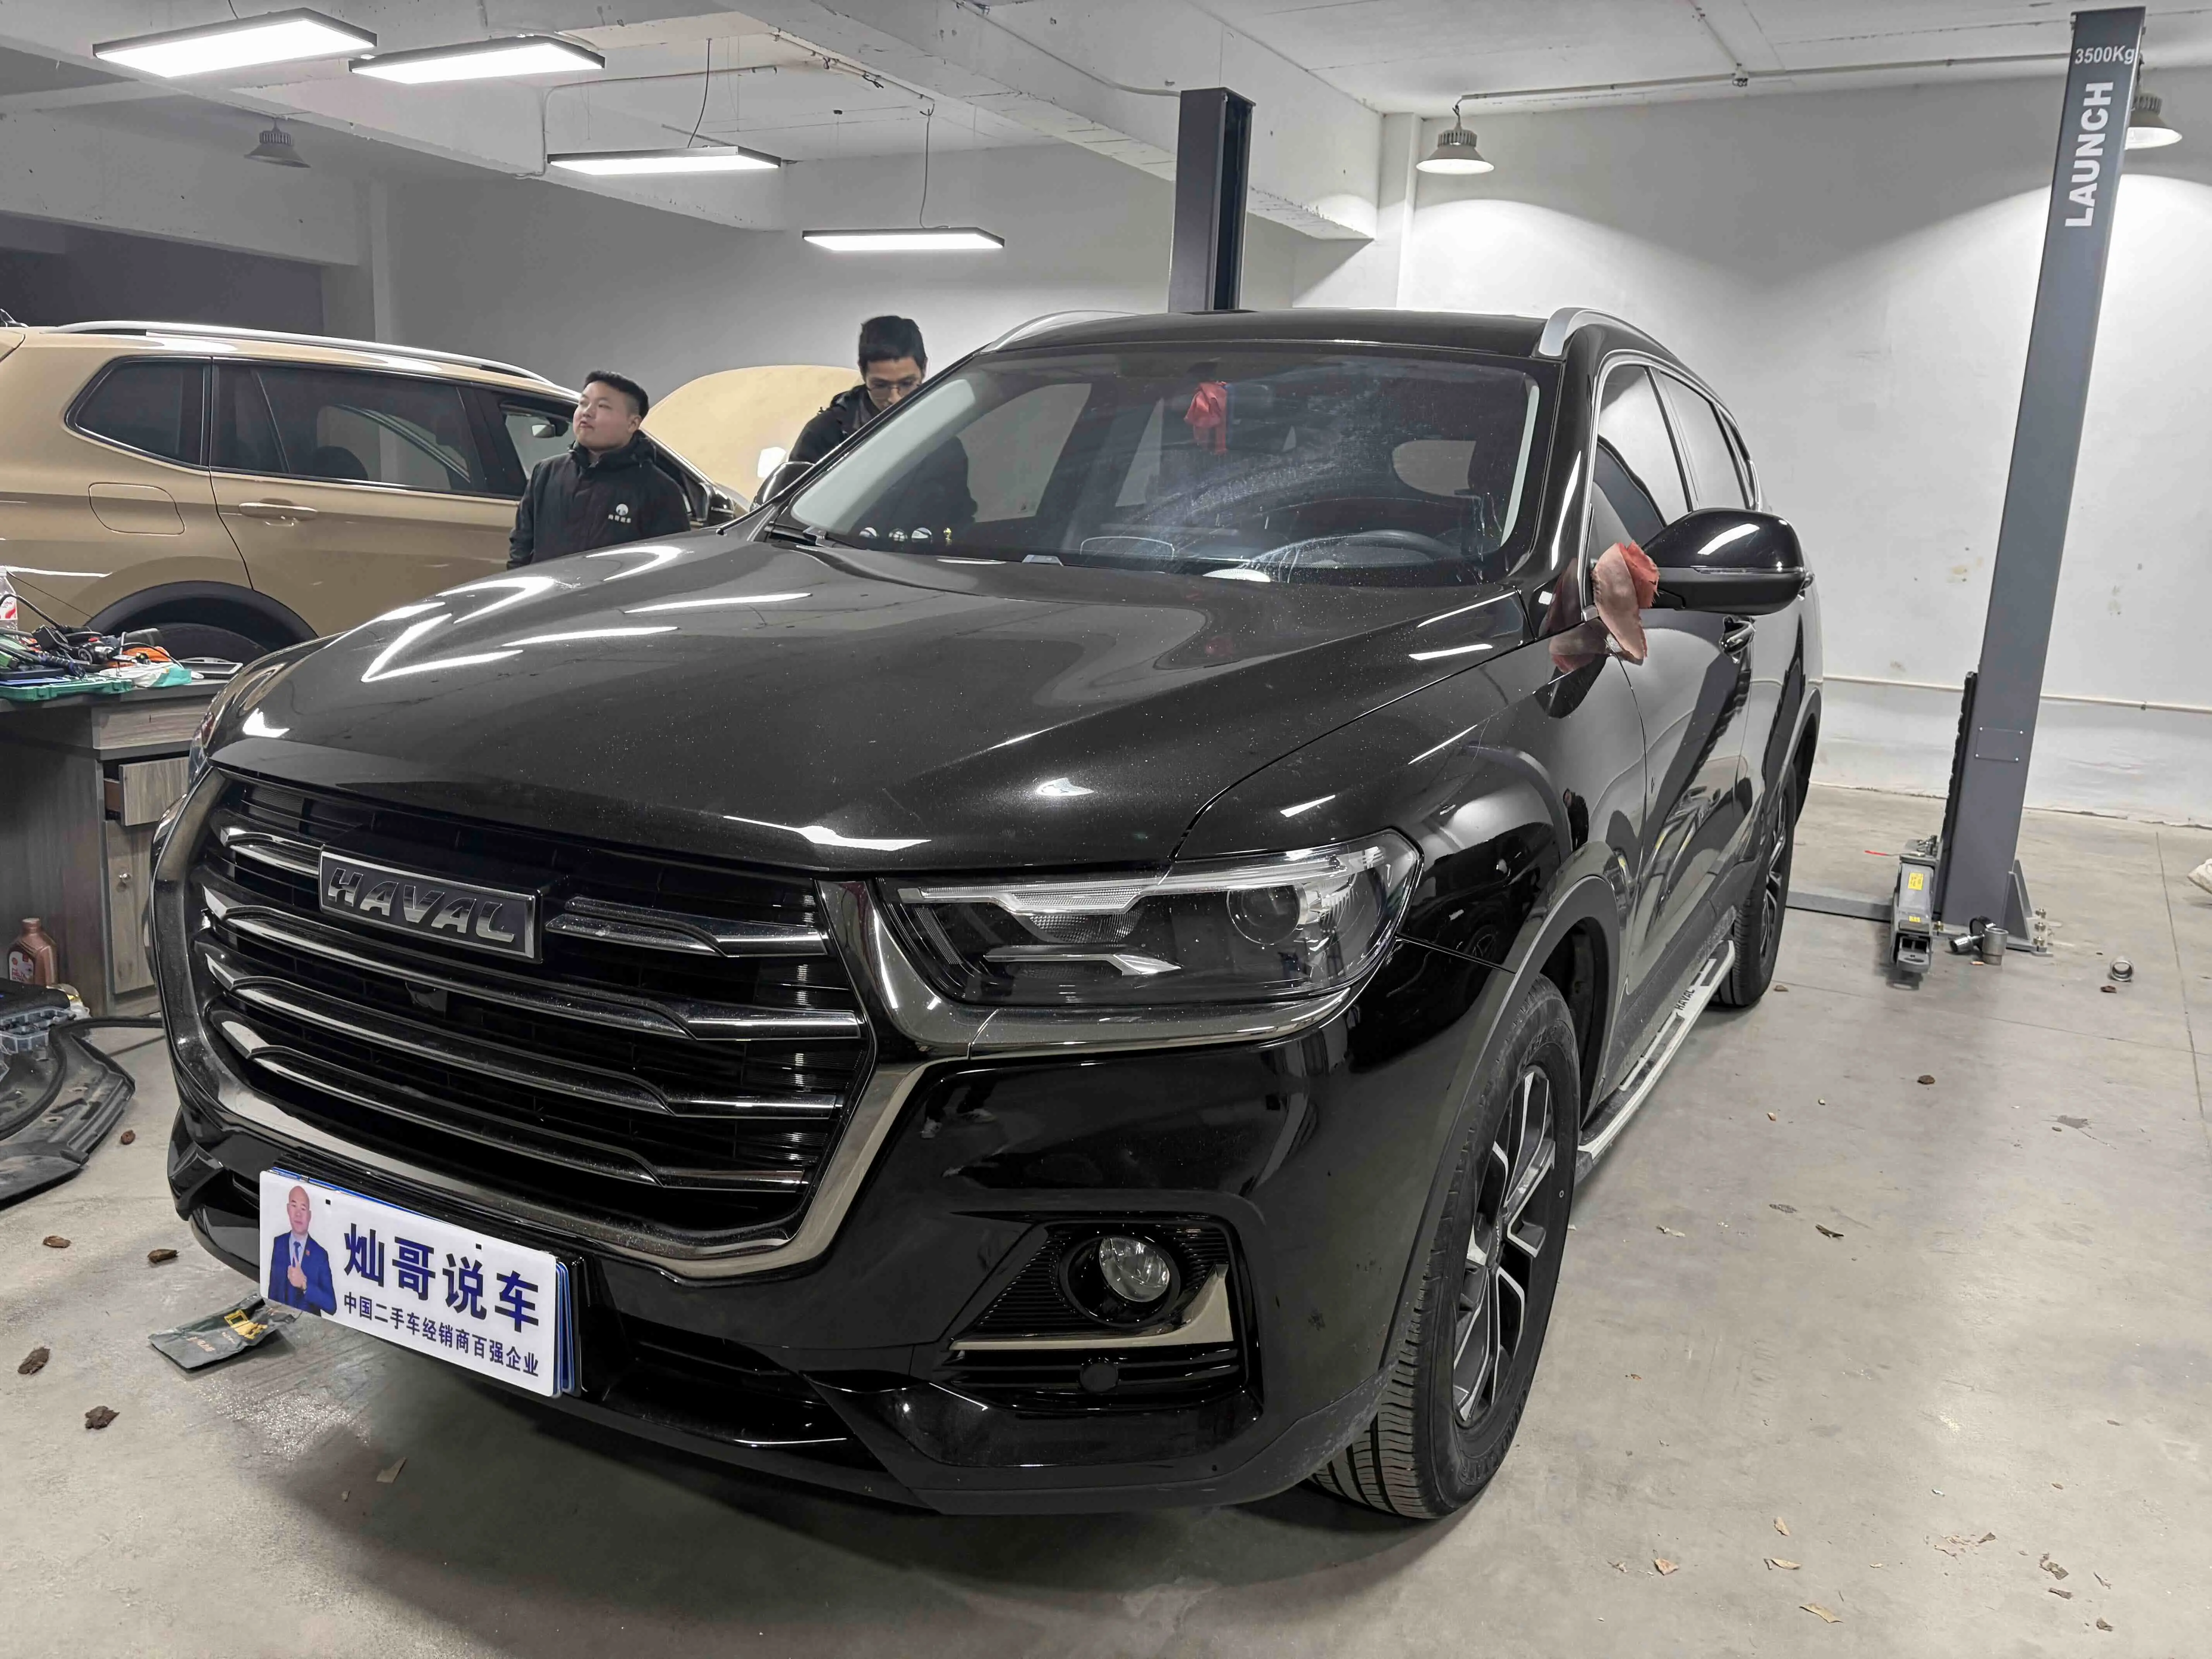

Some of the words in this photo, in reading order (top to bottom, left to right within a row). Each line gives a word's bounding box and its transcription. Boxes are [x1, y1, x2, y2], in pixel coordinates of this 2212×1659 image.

[2075, 45, 2135, 65] 3500Kg
[2065, 82, 2113, 227] LAUNCH
[328, 867, 515, 943] HAVAL
[1674, 990, 1695, 1010] HAVAL
[343, 1223, 539, 1332] 灿哥说车
[344, 1291, 539, 1377] 中国二手车经销商百强企业
